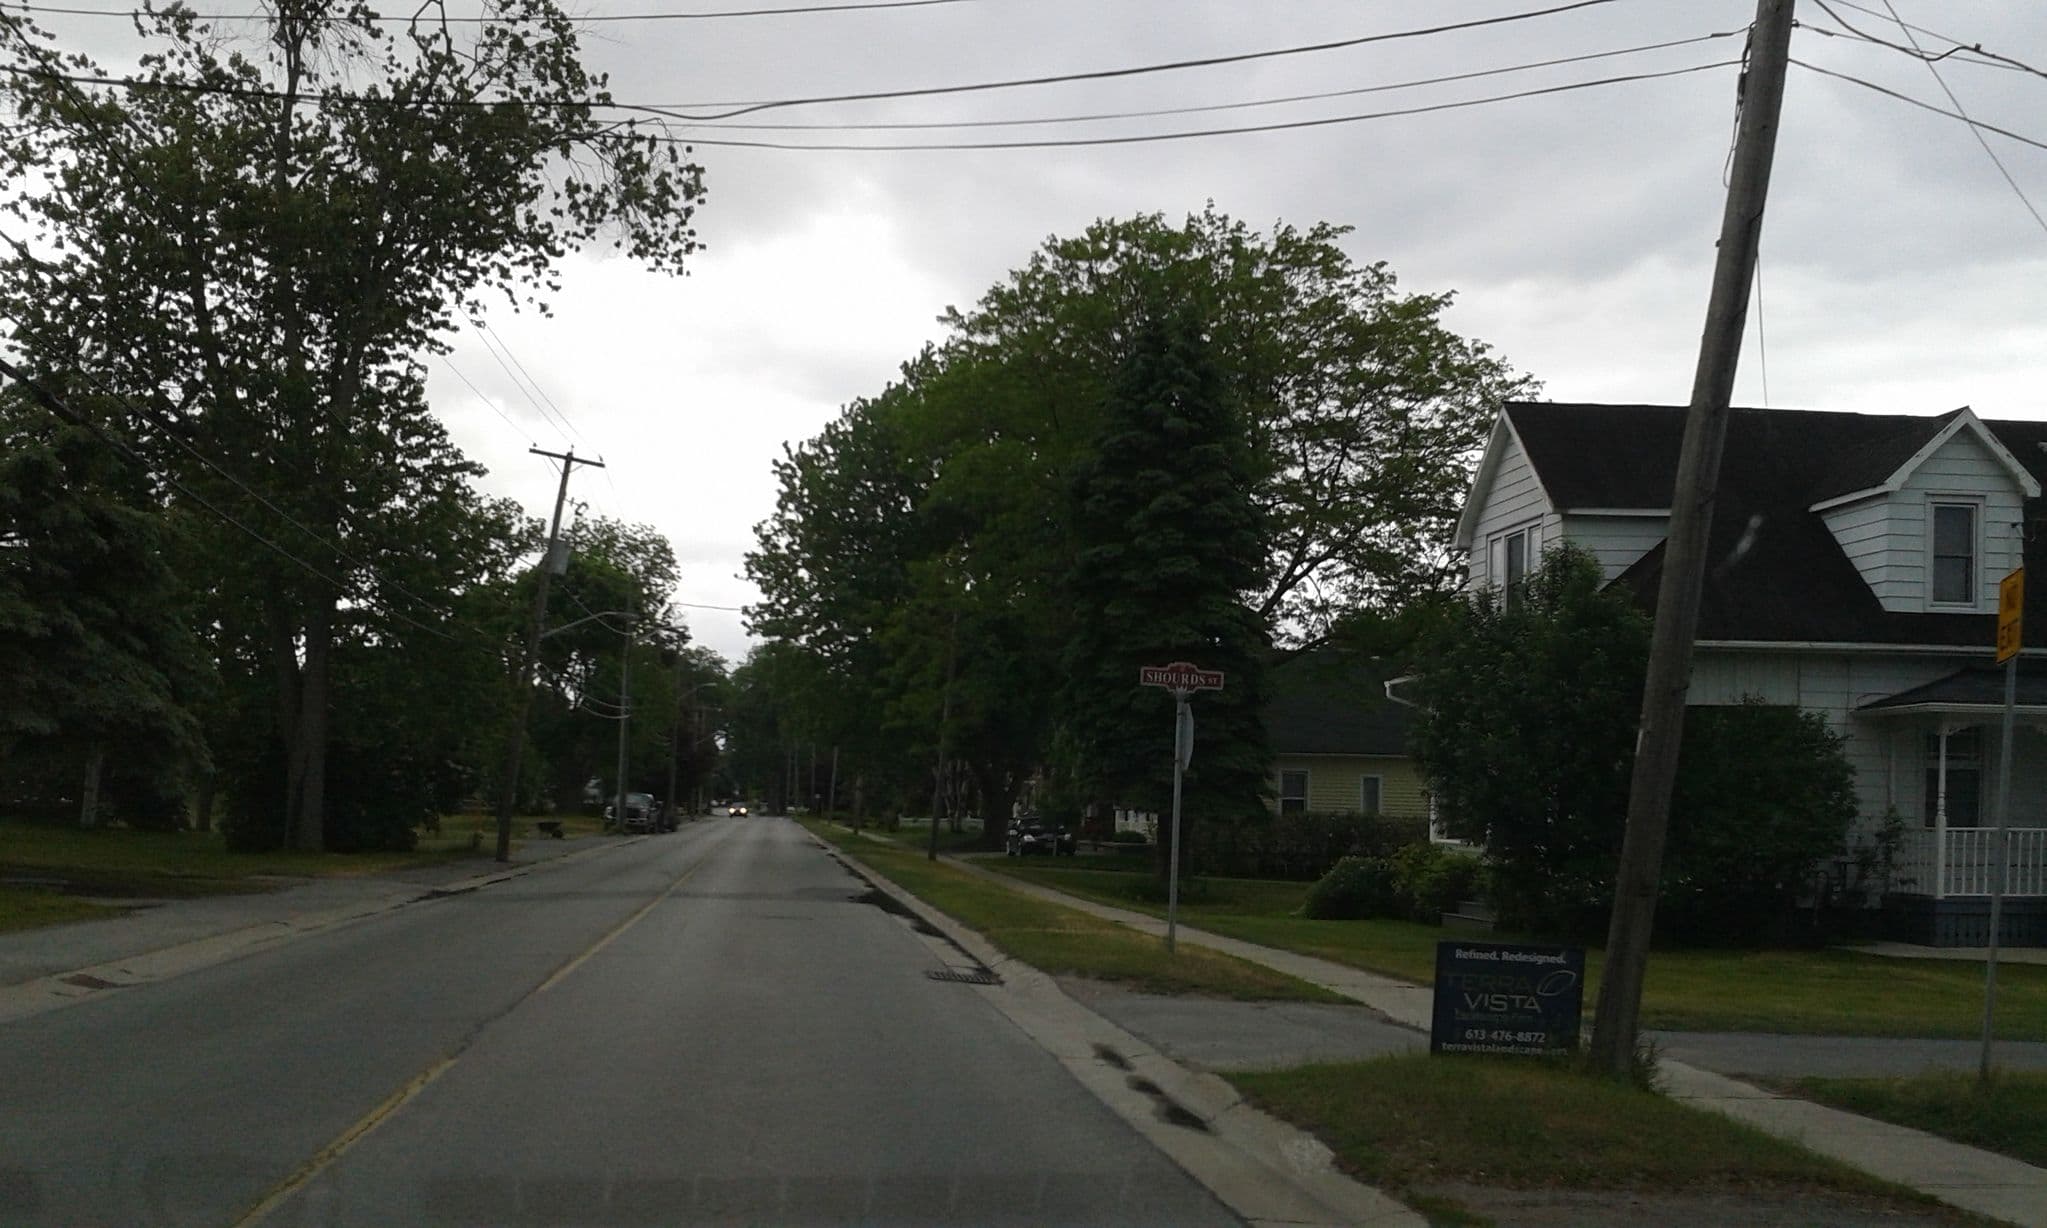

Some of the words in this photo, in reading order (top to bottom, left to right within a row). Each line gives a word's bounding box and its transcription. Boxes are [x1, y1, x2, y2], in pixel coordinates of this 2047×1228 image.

[1146, 671, 1206, 685] SHOURDS
[1455, 949, 1499, 961] Refined.
[1502, 951, 1567, 965] Redesigned.
[1463, 992, 1542, 1013] VISTA
